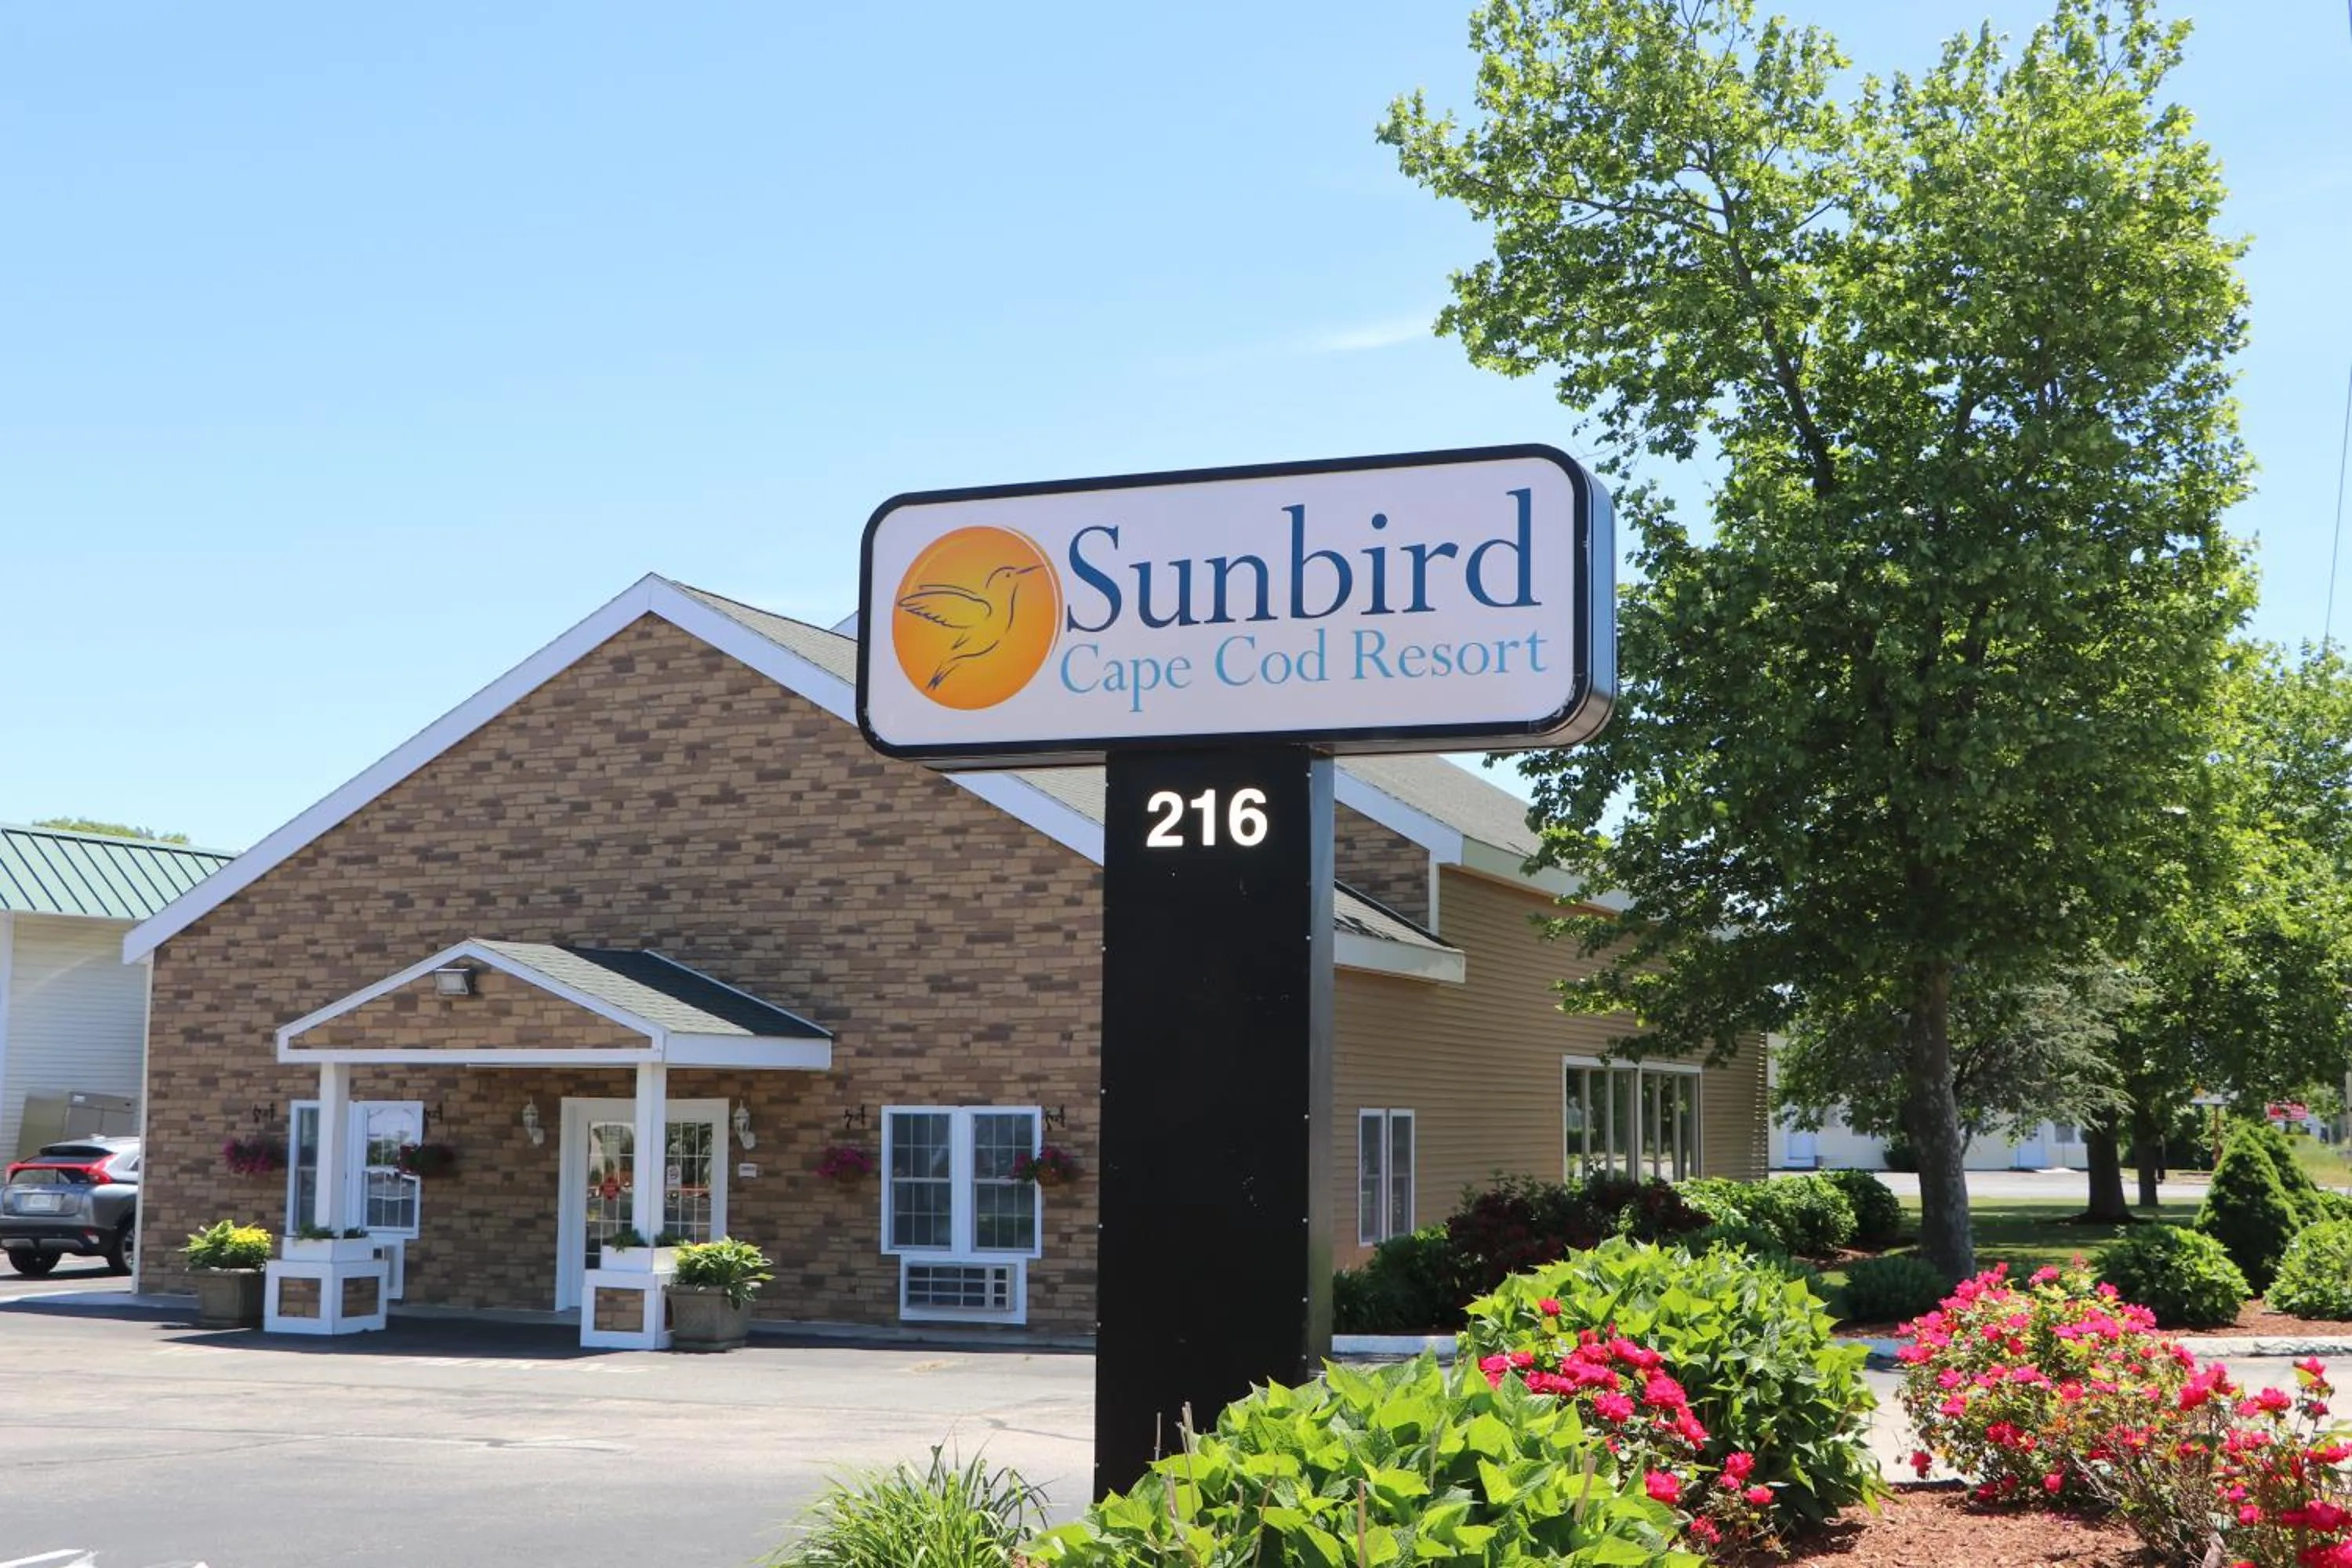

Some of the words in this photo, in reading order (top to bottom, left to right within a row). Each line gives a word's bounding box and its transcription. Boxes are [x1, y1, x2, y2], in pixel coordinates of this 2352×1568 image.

[1066, 488, 1543, 633] Sunbird
[1060, 643, 1192, 713] Cape
[1214, 626, 1330, 687] Cod
[1351, 630, 1548, 681] Resort
[1145, 787, 1268, 848] 216
